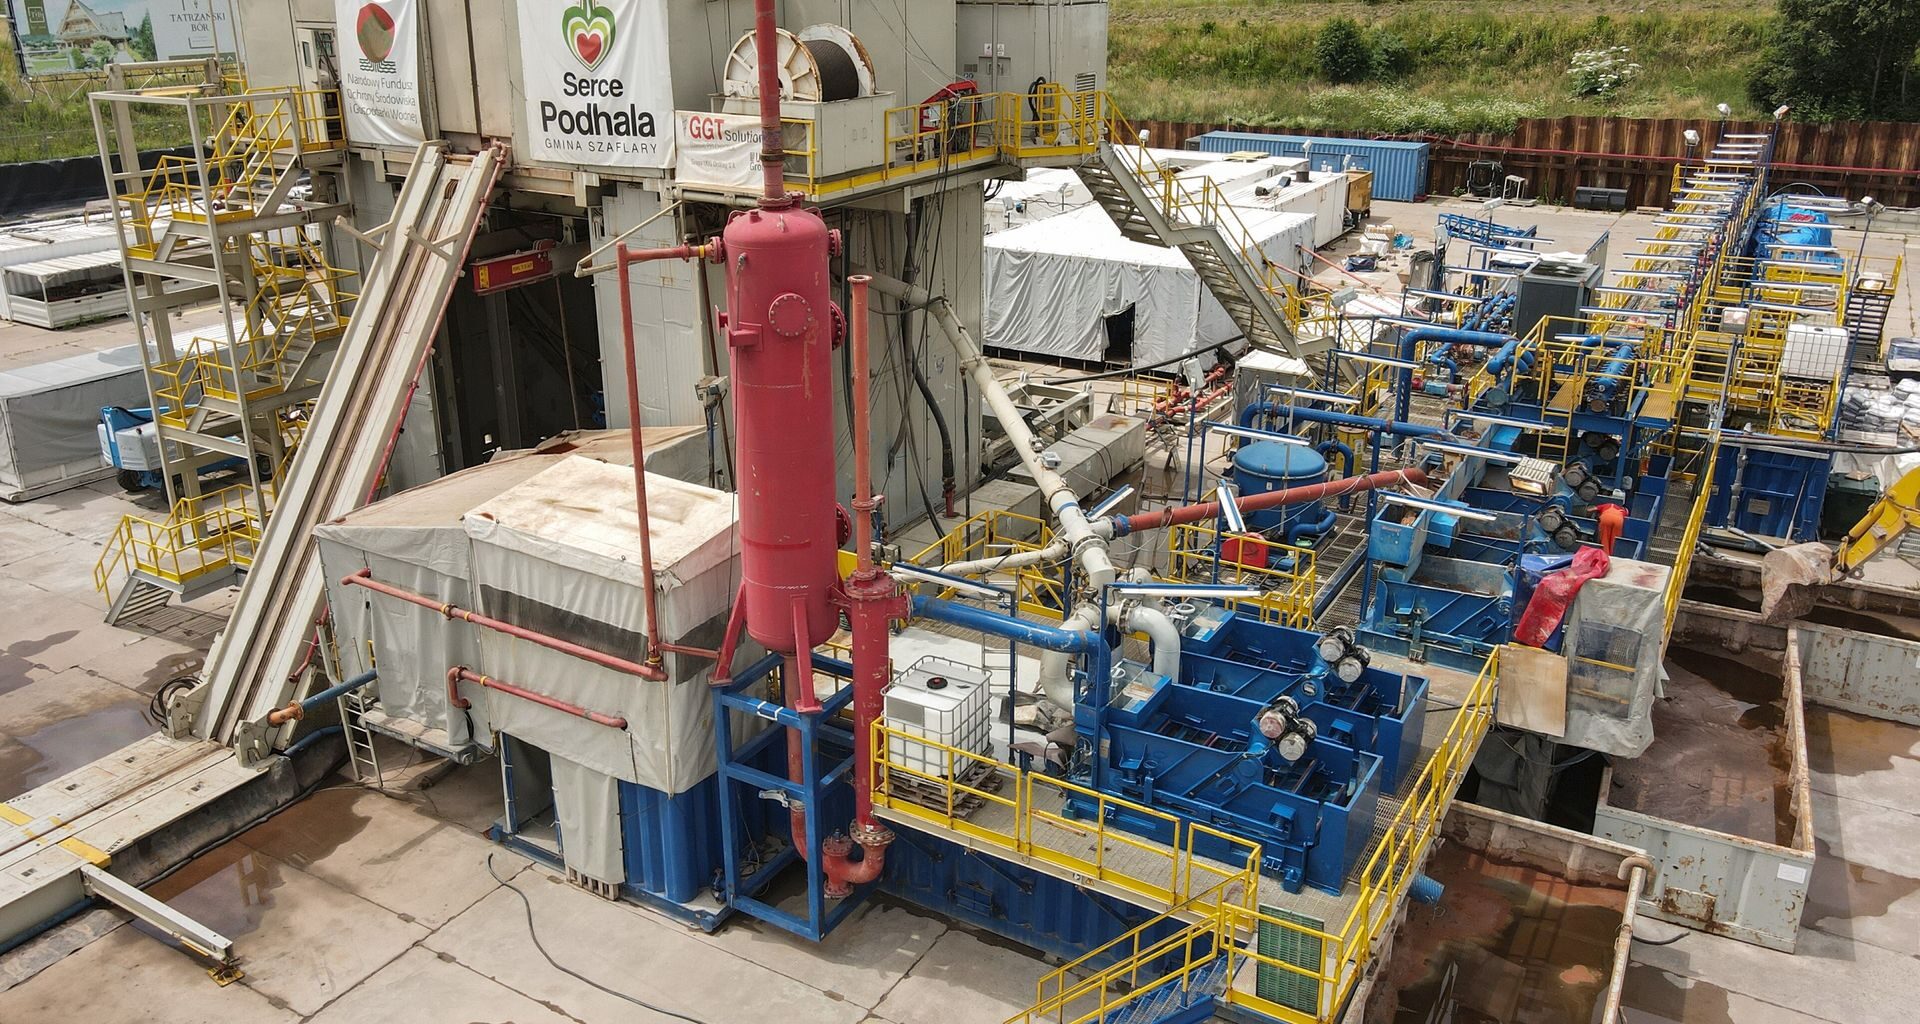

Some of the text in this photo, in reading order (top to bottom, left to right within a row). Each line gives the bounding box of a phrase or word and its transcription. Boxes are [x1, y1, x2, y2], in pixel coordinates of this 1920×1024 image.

[347, 73, 412, 89] Narodowy Fundusz
[563, 72, 623, 97] Serce
[347, 88, 374, 104] Ochrony
[540, 101, 655, 137] Podhala
[690, 116, 762, 143] GGT Solution
[545, 138, 657, 154] GMINA SZAFLARY
